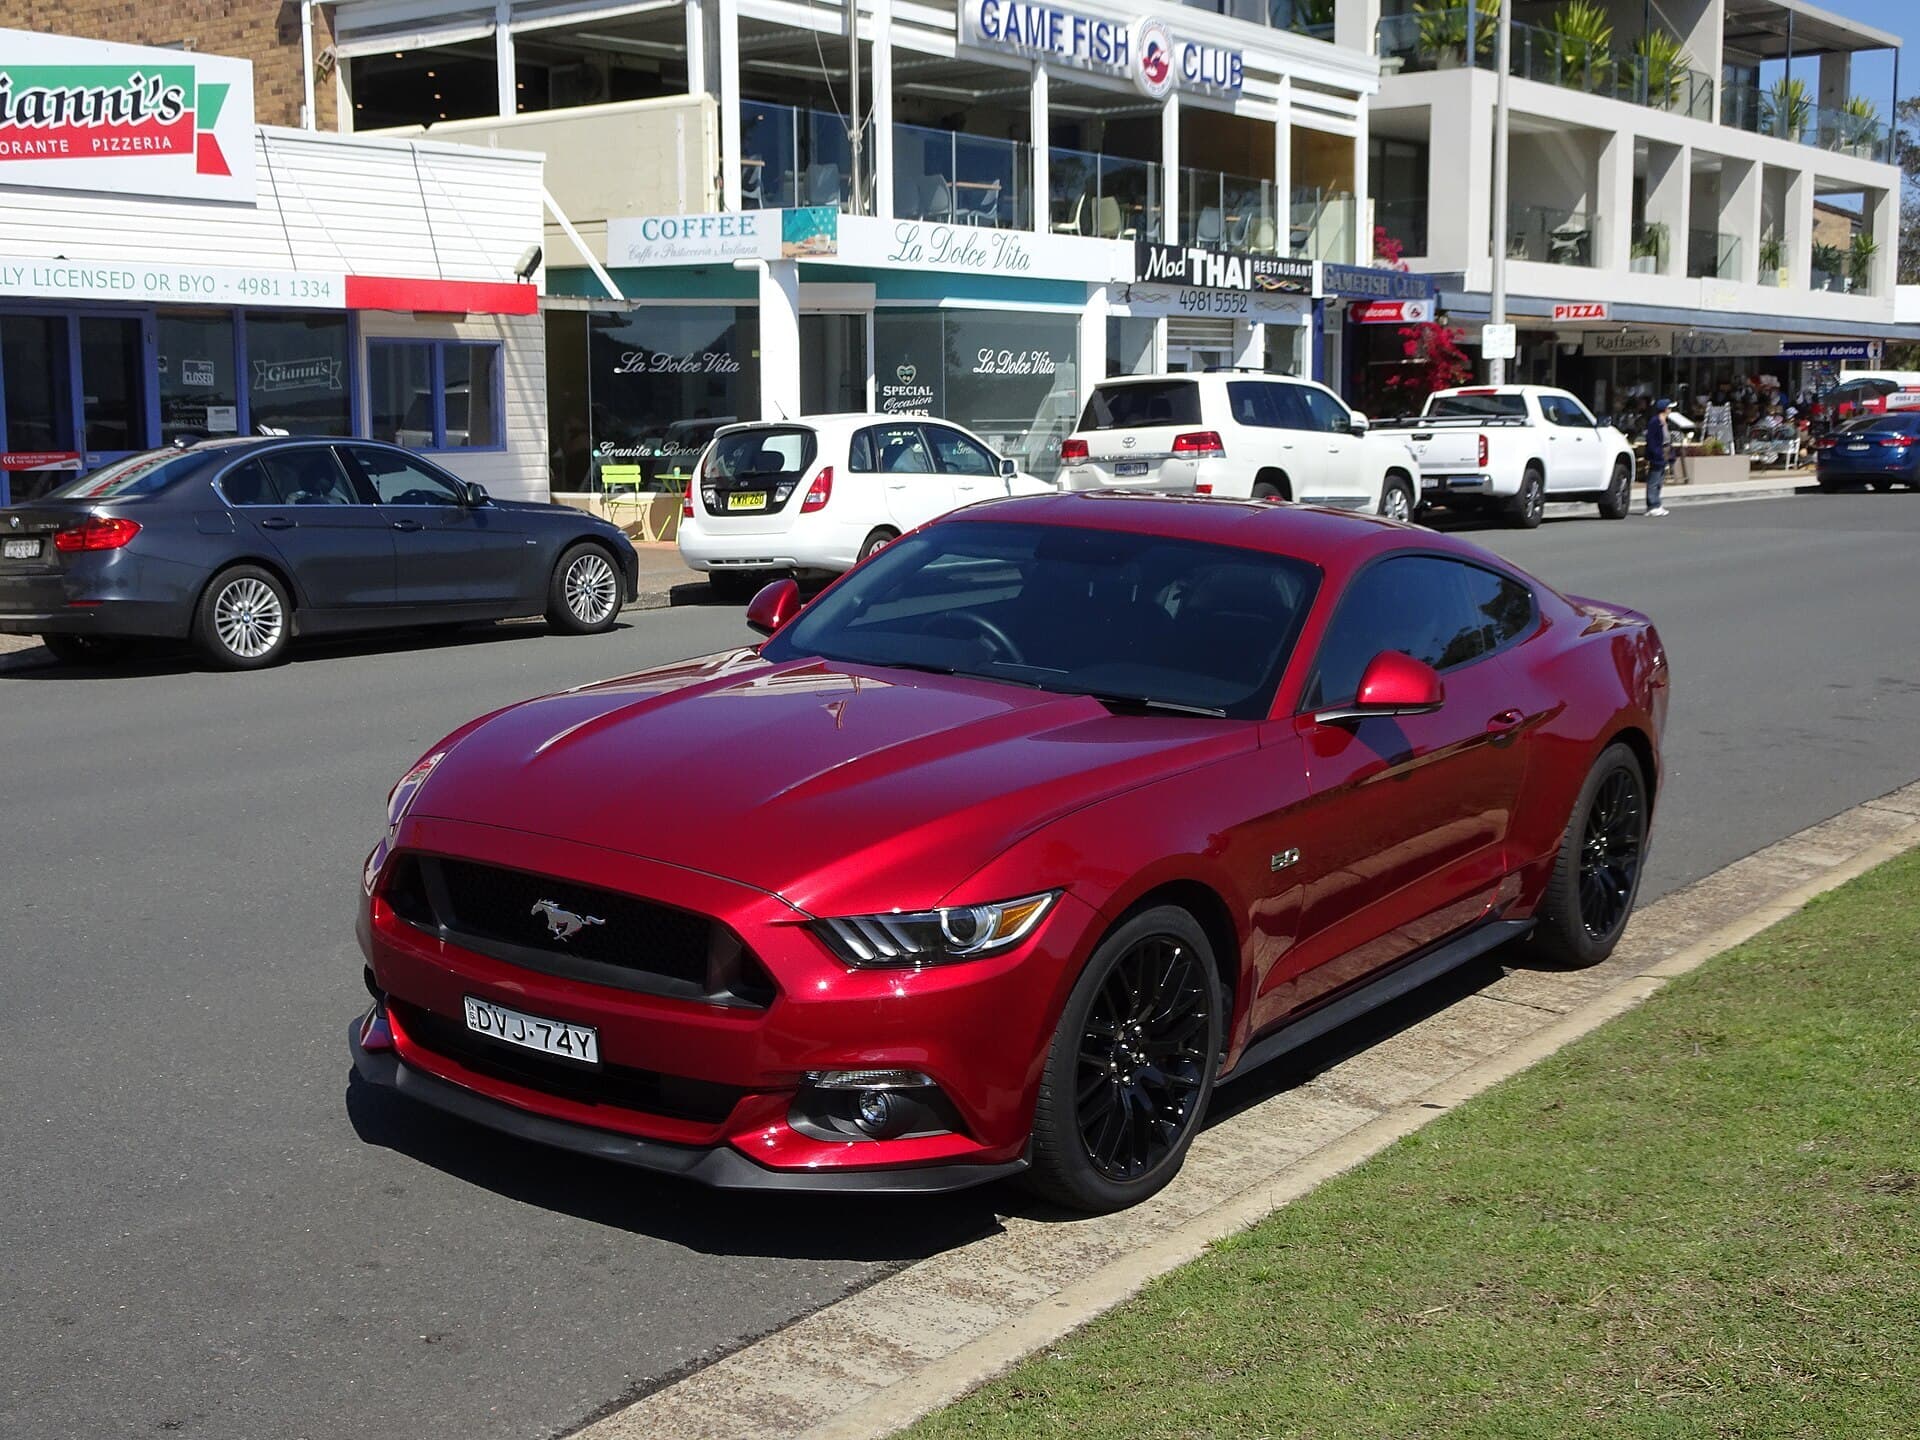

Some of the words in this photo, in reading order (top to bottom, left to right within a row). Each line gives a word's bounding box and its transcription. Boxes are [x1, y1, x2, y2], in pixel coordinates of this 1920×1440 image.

[979, 0, 1065, 52] GAME
[1073, 17, 1130, 65] FISH
[1183, 43, 1244, 89] CLUB
[0, 139, 70, 155] ORANTE
[92, 136, 172, 151] PIZZERIA
[642, 215, 757, 241] COFFEE
[888, 222, 924, 262] La
[928, 226, 987, 267] Dolce
[992, 233, 1031, 270] Vita
[1145, 247, 1186, 280] Mod
[1188, 248, 1251, 290] THAI
[1254, 260, 1312, 277] RESTAURANT
[0, 268, 24, 286] LY
[33, 268, 136, 290] LICENSED
[144, 272, 171, 292] OR
[179, 273, 216, 294] BYO
[237, 277, 281, 297] 4981
[290, 280, 331, 298] 1334
[1179, 290, 1212, 312] 4981
[1215, 294, 1248, 313] 5552
[1555, 304, 1605, 319] PIZZA
[614, 351, 646, 374] La
[647, 352, 702, 373] Dolce
[702, 352, 740, 373] Vita
[973, 348, 995, 374] La
[996, 350, 1031, 375] Dolce
[1031, 350, 1056, 375] Vita
[1829, 346, 1864, 356] Advice
[267, 361, 330, 382] Gianni's
[883, 386, 933, 396] SPECIAL
[883, 396, 933, 411] Occasion
[599, 441, 651, 457] Granita
